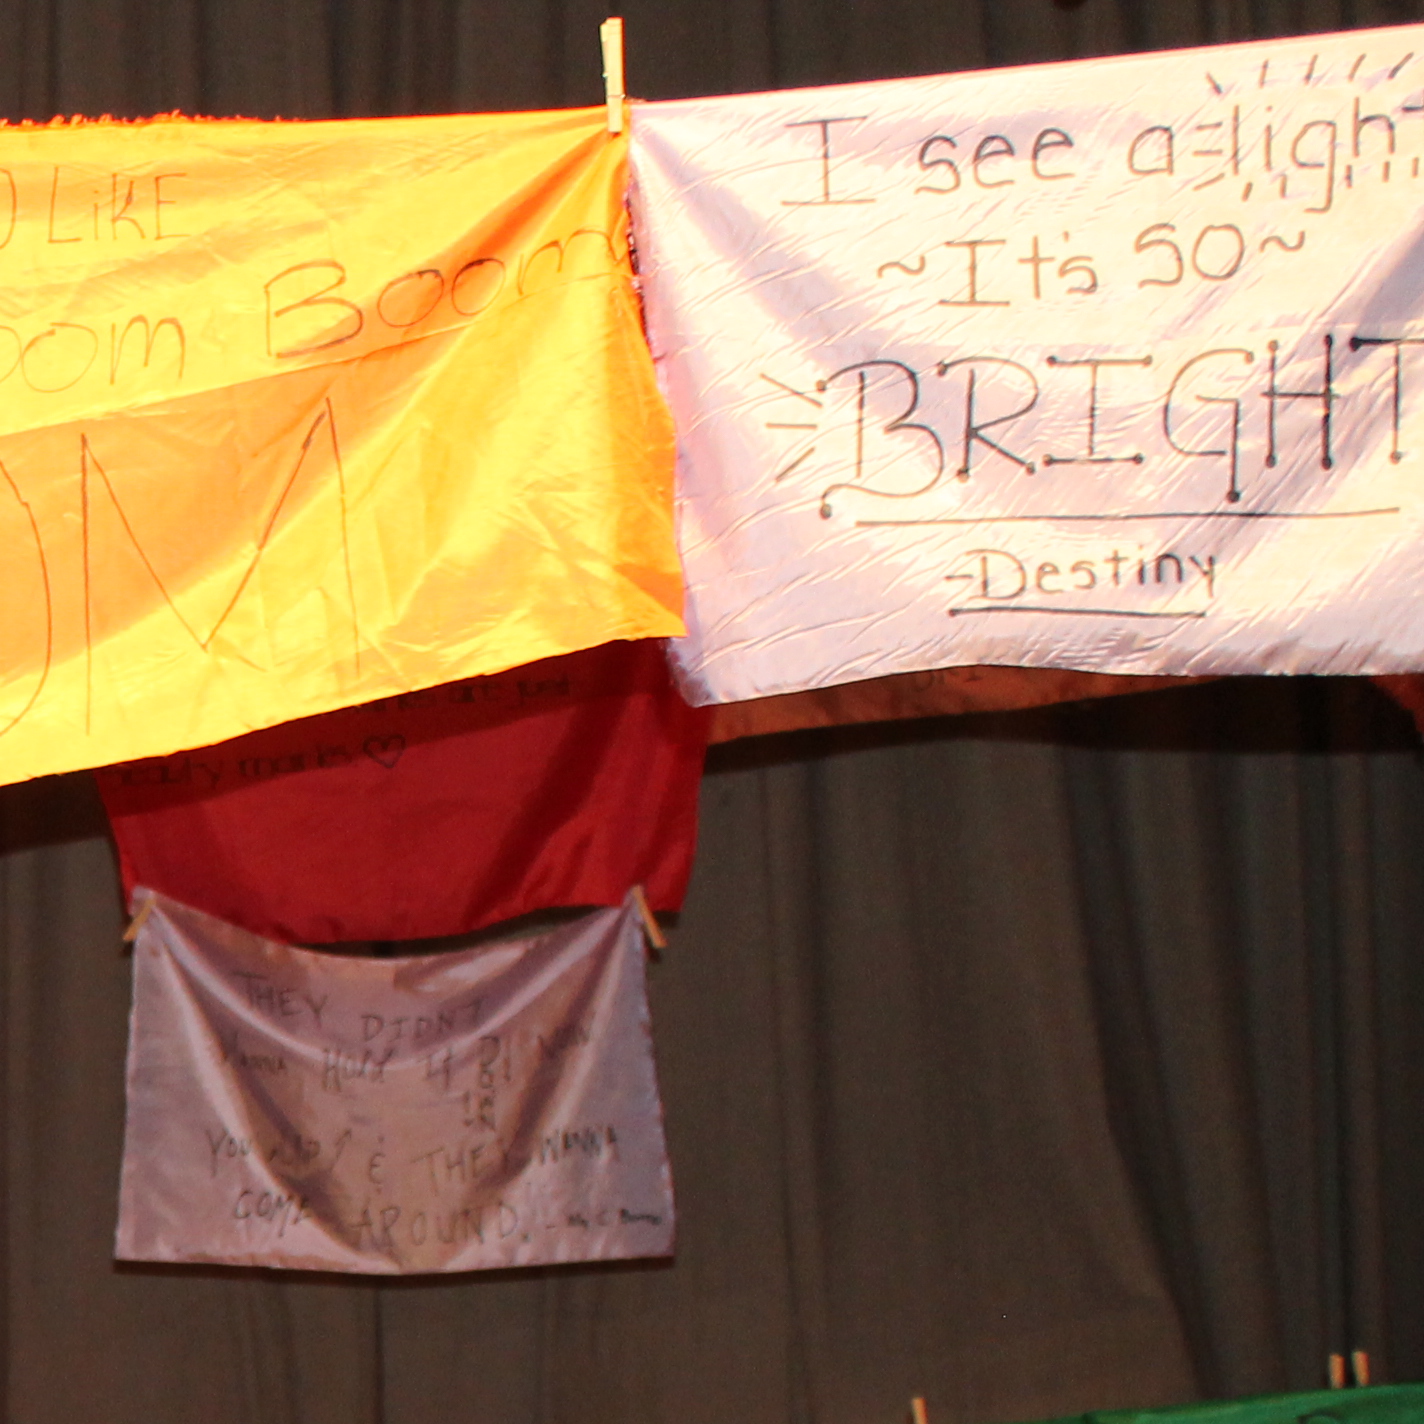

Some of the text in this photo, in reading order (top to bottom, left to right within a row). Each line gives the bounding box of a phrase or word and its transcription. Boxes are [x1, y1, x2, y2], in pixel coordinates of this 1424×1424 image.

[781, 115, 877, 206] I
[914, 127, 1075, 195] see
[1127, 124, 1176, 176] a
[816, 332, 1424, 517] BRIGHT
